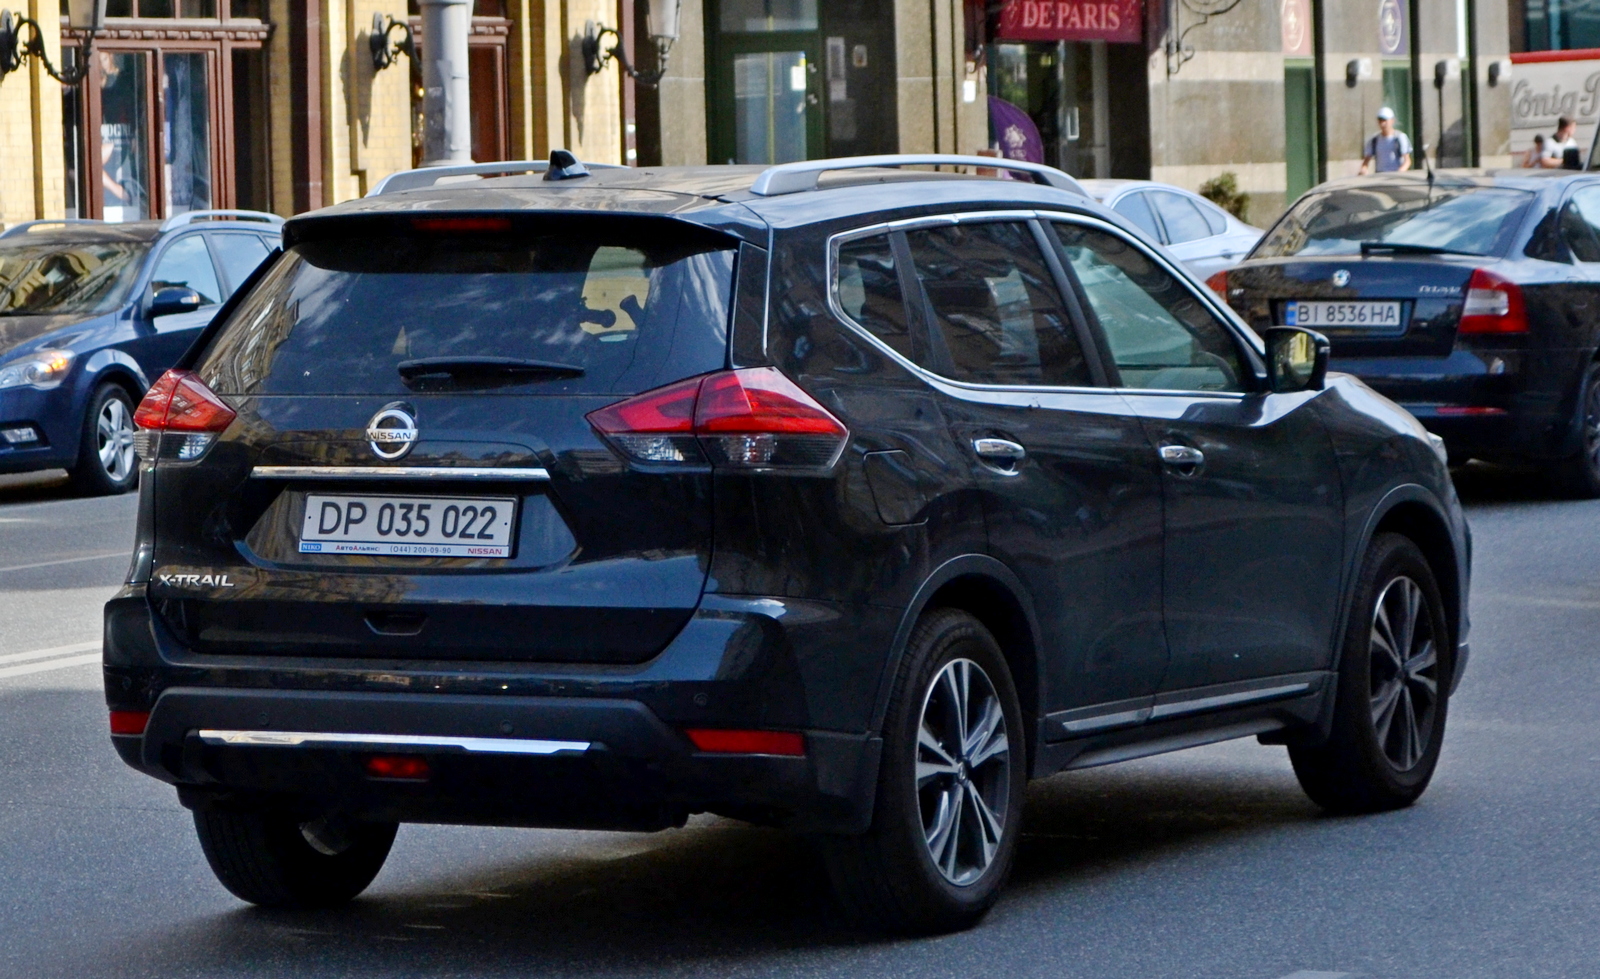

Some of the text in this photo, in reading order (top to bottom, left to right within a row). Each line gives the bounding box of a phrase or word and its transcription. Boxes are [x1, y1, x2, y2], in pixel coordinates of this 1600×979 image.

[1022, 0, 1120, 30] DE PARIS
[1298, 305, 1396, 323] BI 8536 HA
[370, 432, 411, 440] NISSAN
[318, 501, 497, 540] DP 035 022
[302, 543, 321, 551] NIKO
[390, 545, 411, 553] (044)
[413, 546, 452, 554] 200-09-90
[158, 574, 235, 587] X-TRAIL
